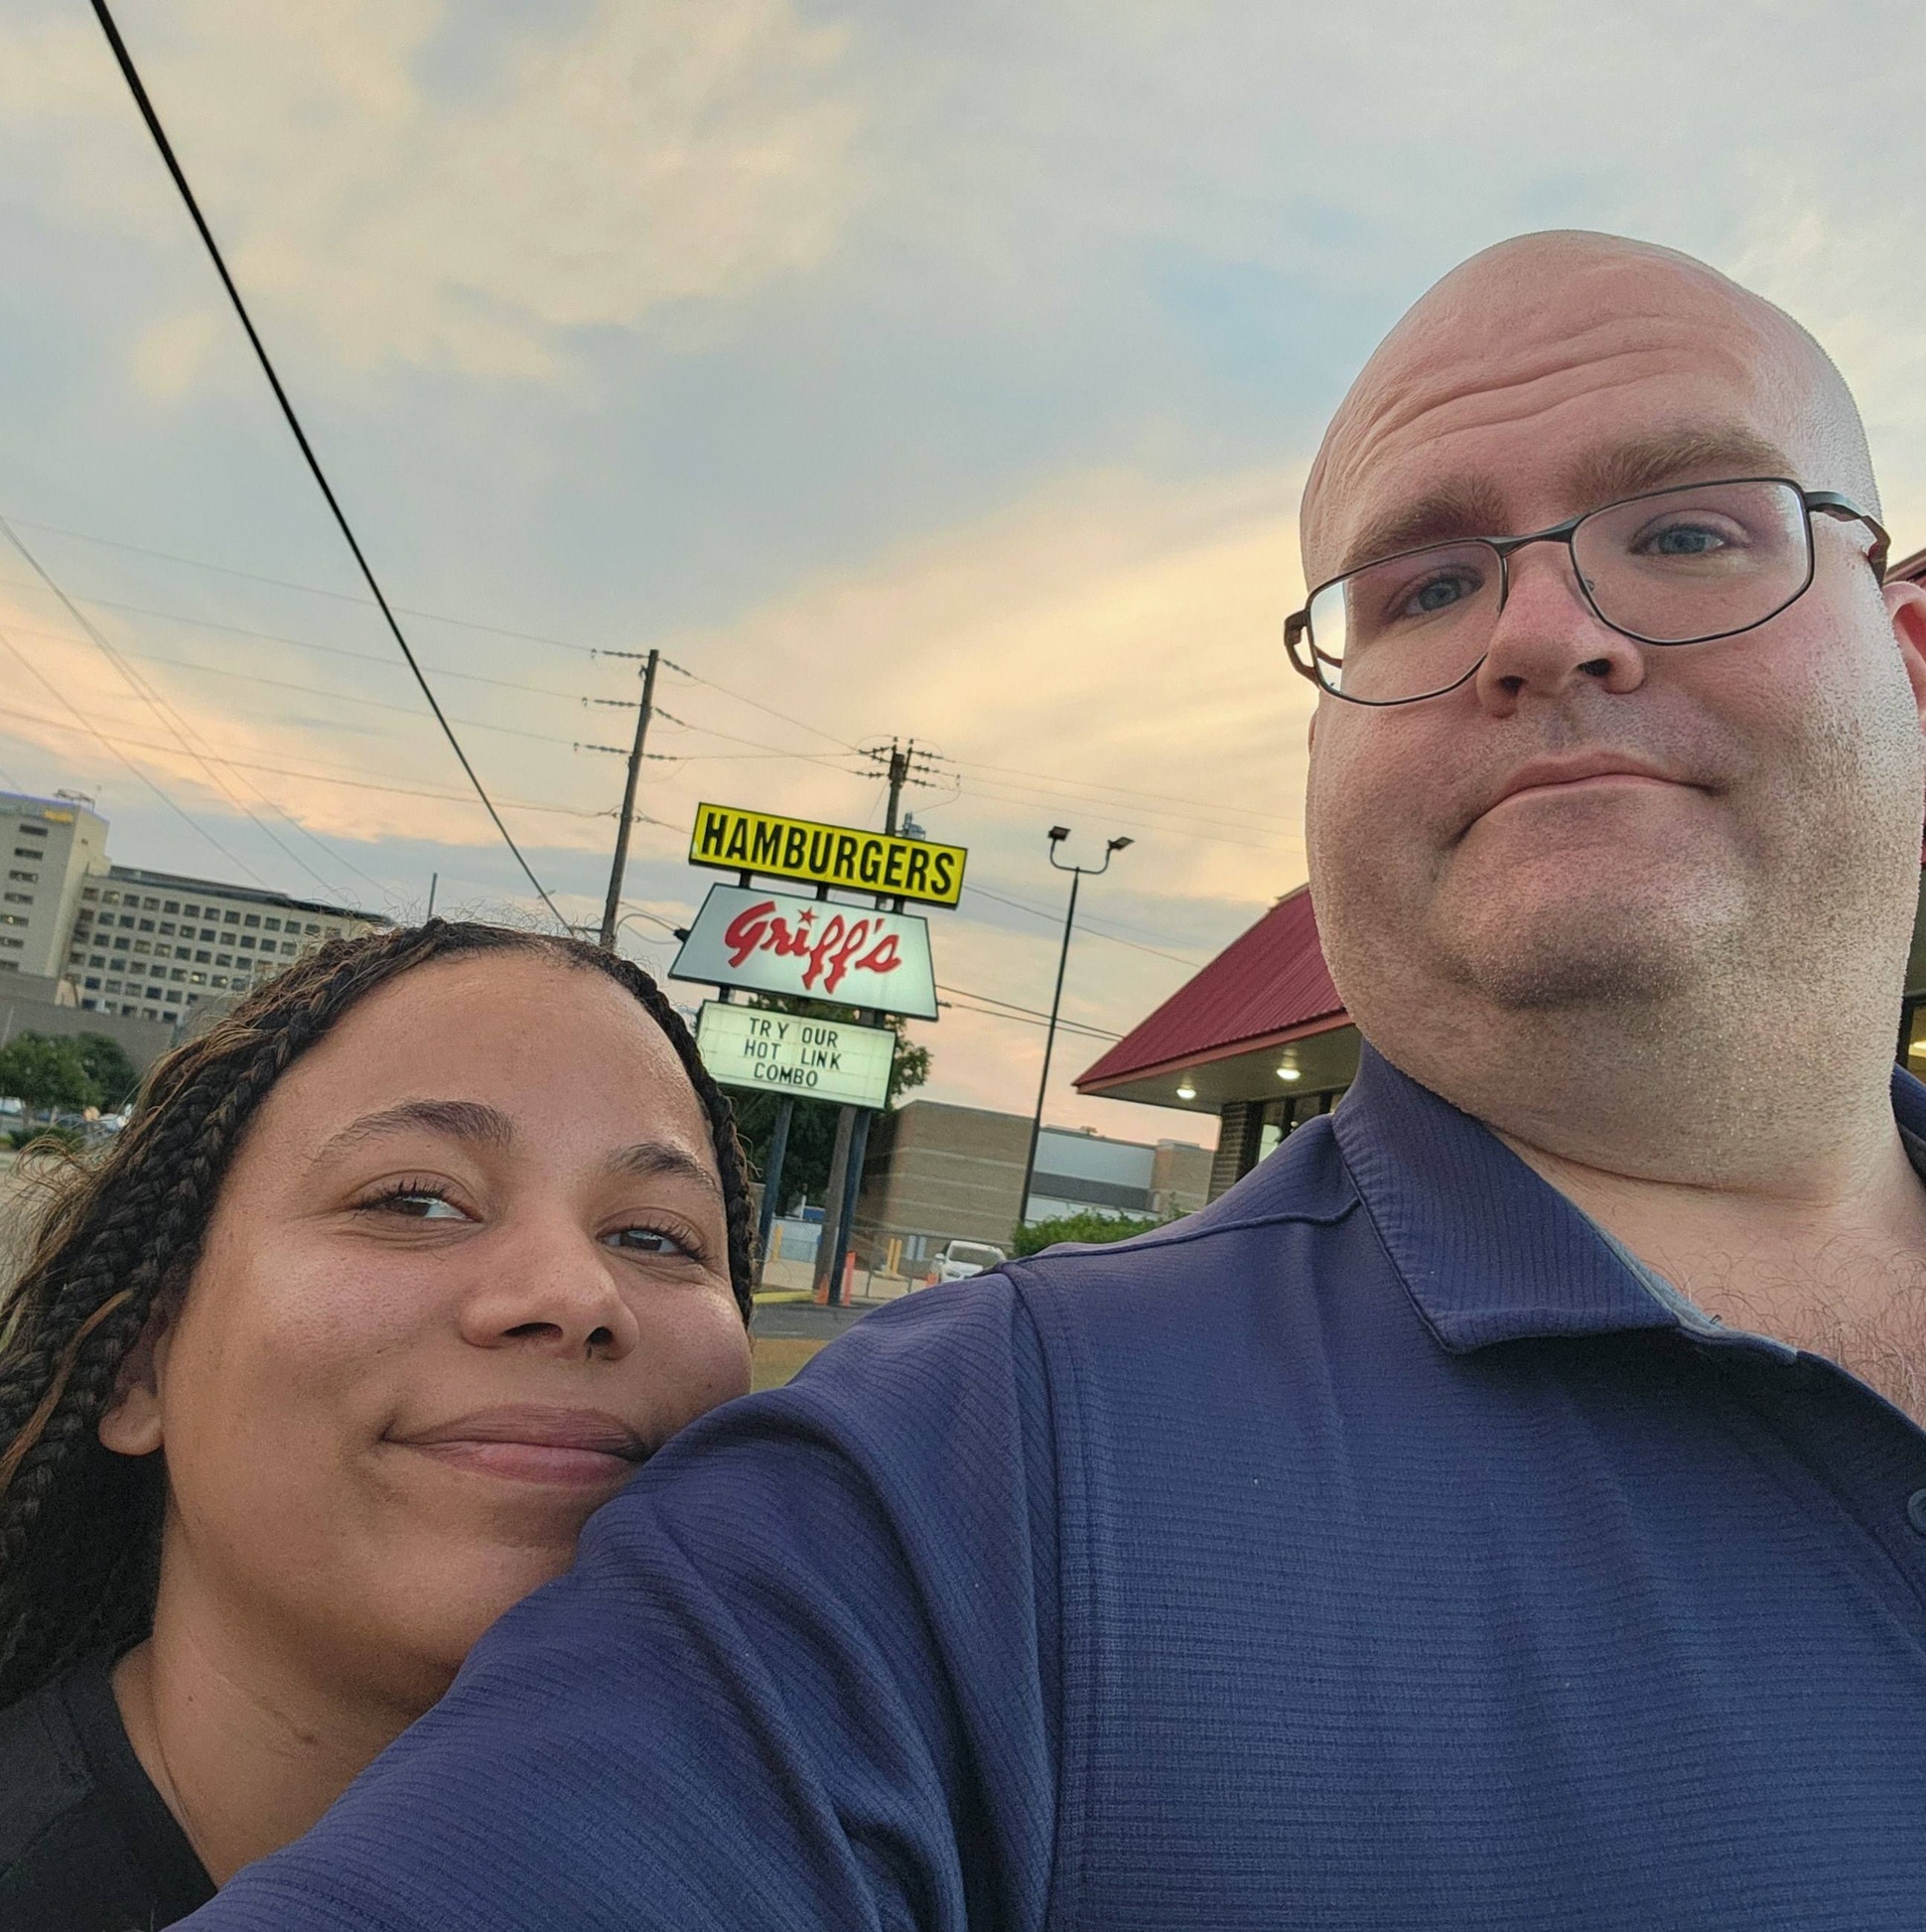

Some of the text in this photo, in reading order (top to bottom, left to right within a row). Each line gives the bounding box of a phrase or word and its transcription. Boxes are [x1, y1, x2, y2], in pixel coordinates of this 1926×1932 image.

[701, 812, 955, 896] HAMBURGERS
[724, 900, 902, 995] Griff's
[750, 1017, 839, 1048] TRY OUR
[744, 1038, 842, 1070] HOT LINK
[754, 1061, 818, 1087] COMBO
